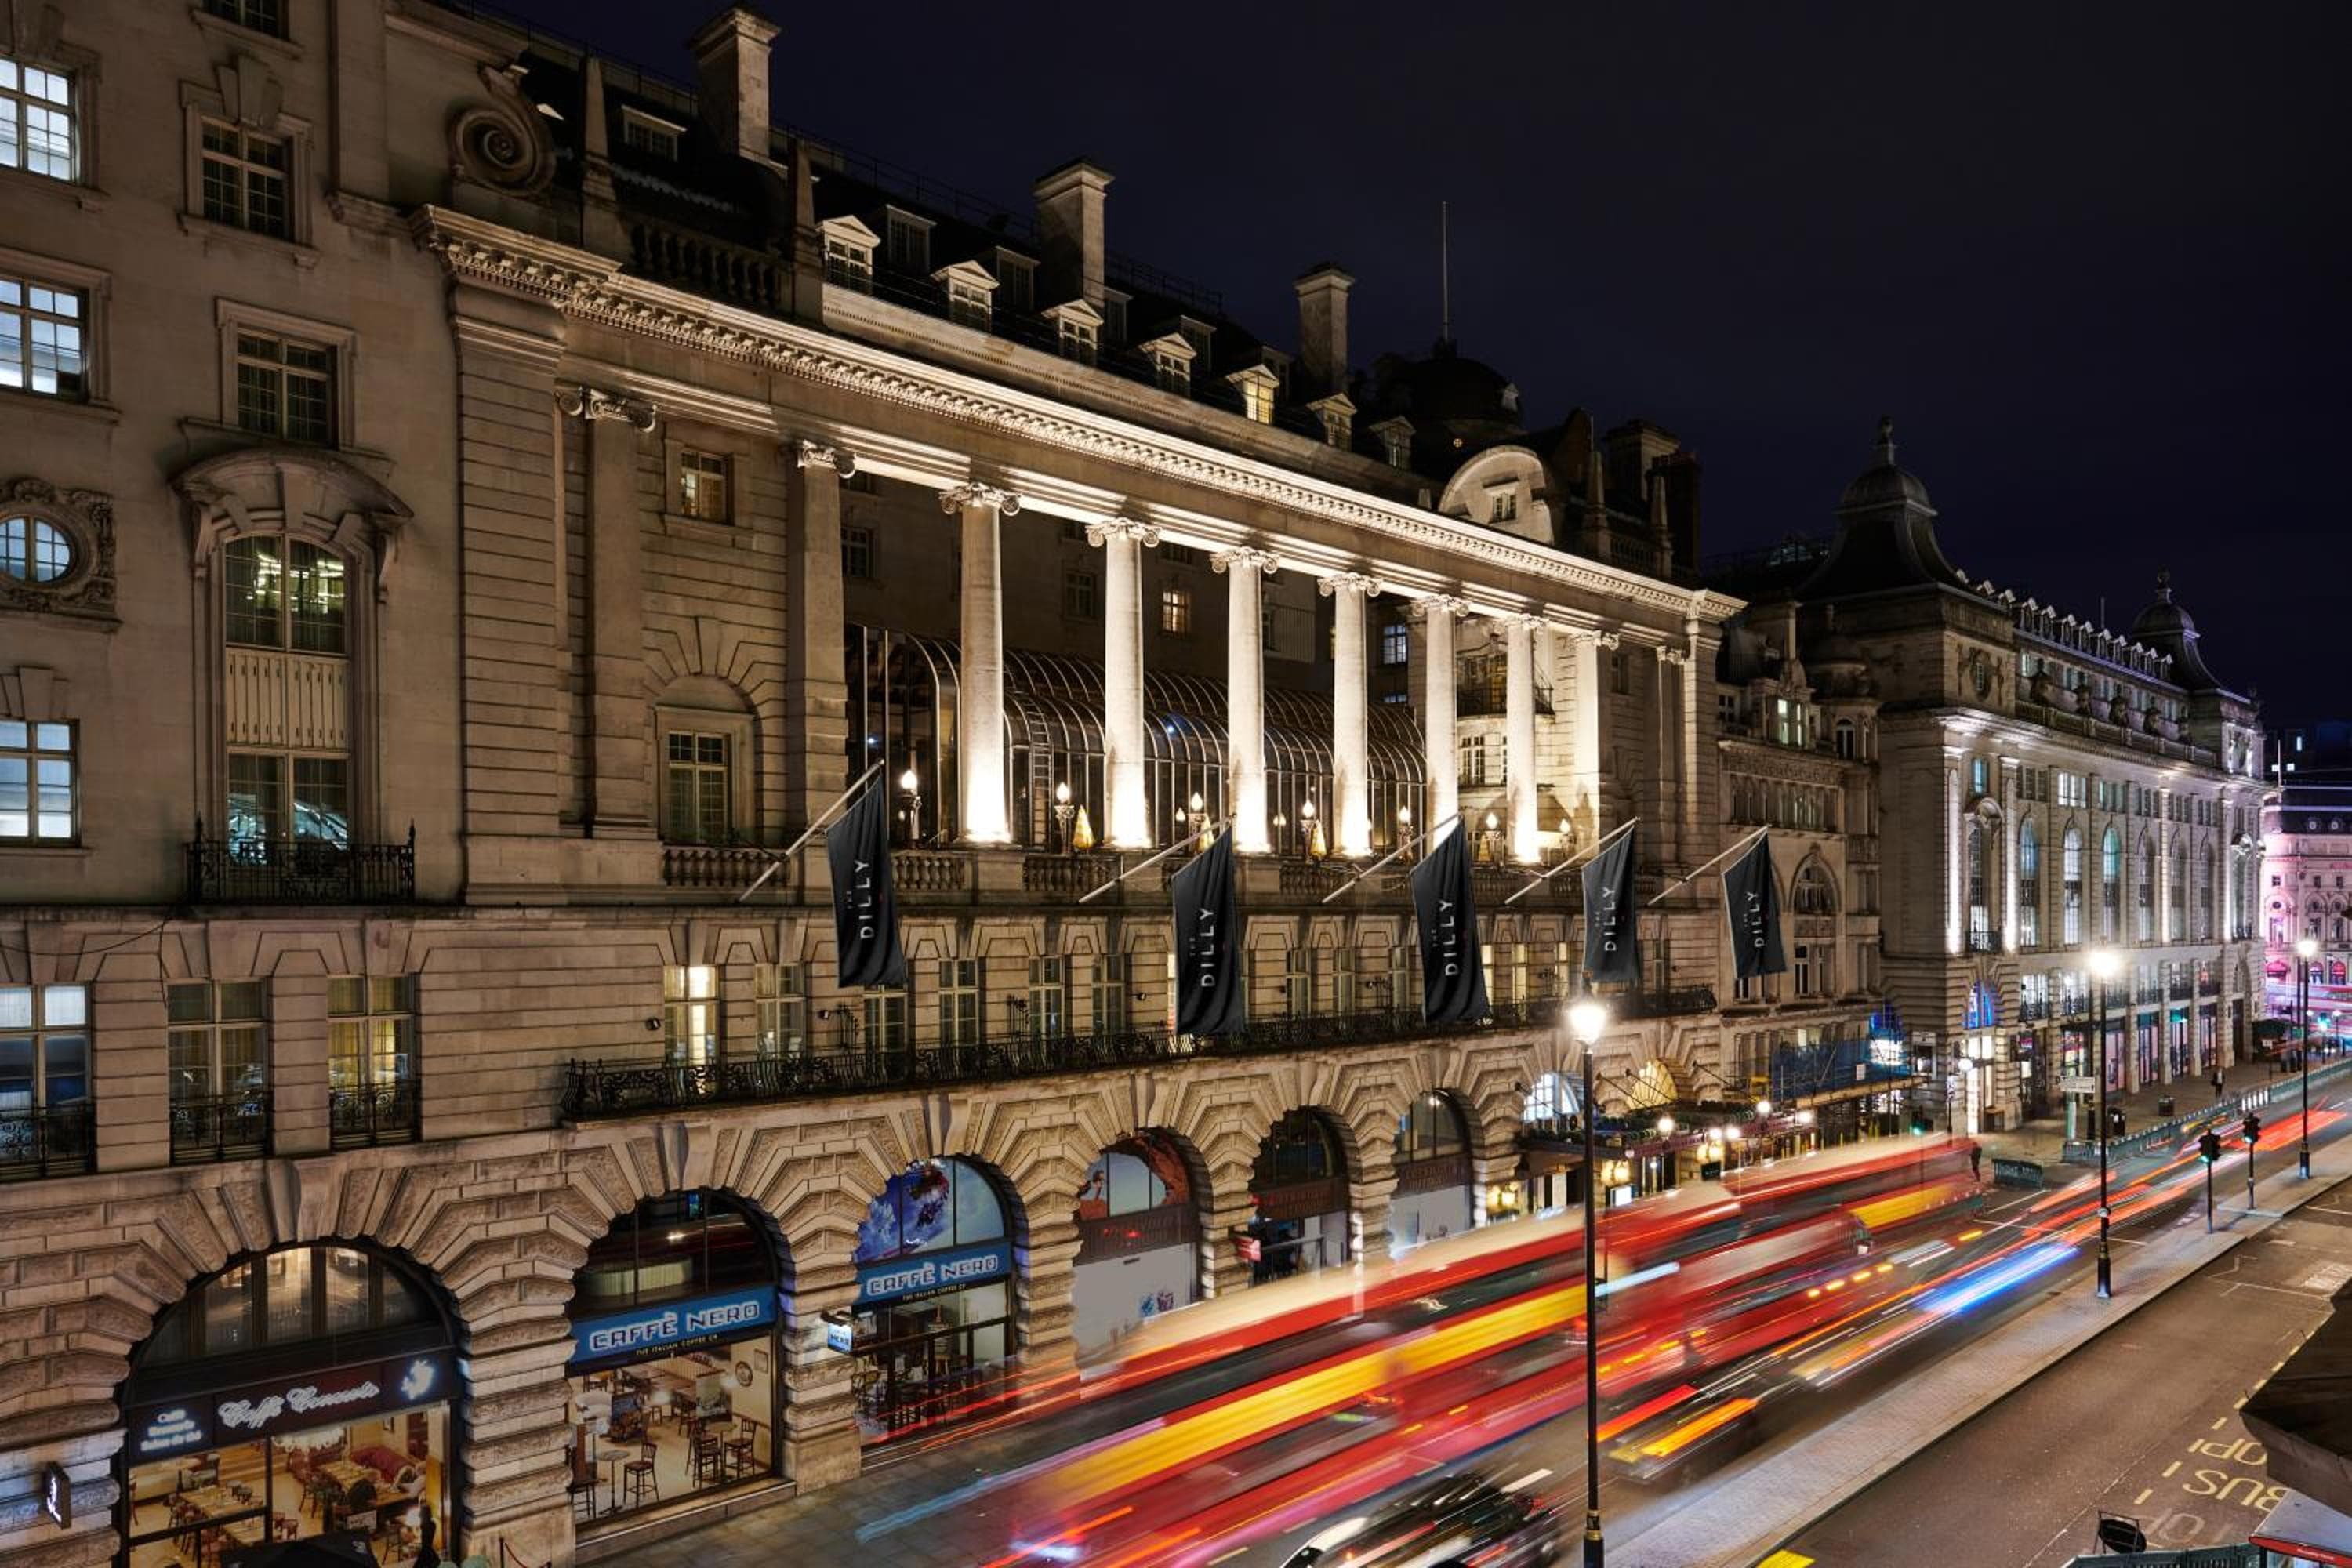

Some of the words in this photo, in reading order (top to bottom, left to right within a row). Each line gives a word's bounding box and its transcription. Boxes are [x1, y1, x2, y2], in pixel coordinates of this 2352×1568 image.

[854, 860, 874, 939] DILLY
[1602, 887, 1617, 951] DILLY
[1747, 891, 1765, 947] DILLY
[1199, 908, 1216, 987] DILLY
[1439, 900, 1458, 976] DILLY
[941, 1254, 998, 1282] NERO
[685, 1299, 760, 1333] NERO
[2182, 1468, 2294, 1513] BUS
